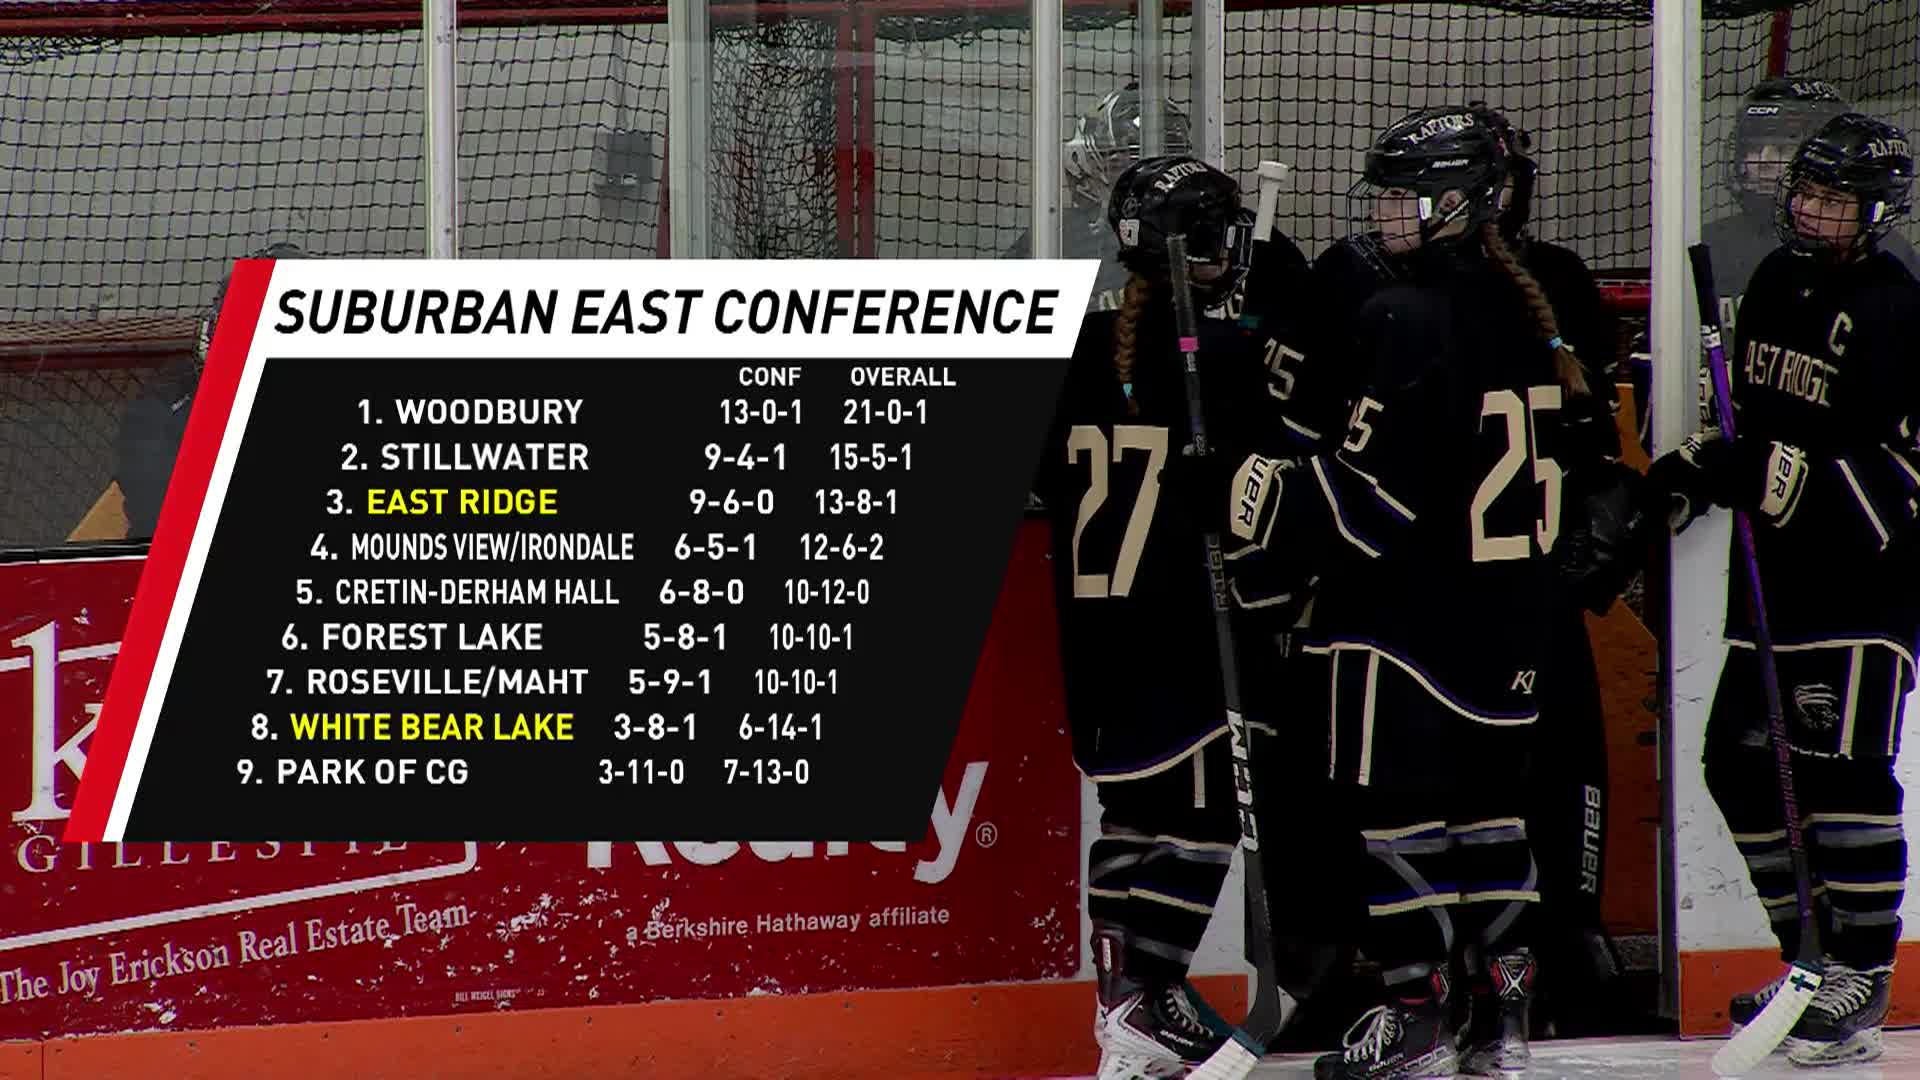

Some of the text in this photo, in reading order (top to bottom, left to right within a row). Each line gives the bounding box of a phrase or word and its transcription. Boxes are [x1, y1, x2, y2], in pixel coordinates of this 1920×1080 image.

[1409, 113, 1474, 144] RAPTORS
[1747, 106, 1779, 115] CCM
[1829, 311, 1854, 356] C
[1778, 349, 1839, 408] RIDGE
[1470, 385, 1562, 562] 25
[1067, 425, 1169, 598] 27
[1579, 784, 1601, 895] BAUER
[0, 900, 470, 1002] The Joy Erickson Real Estate Team
[626, 906, 950, 941] a Berkshire Hathaway affiliate
